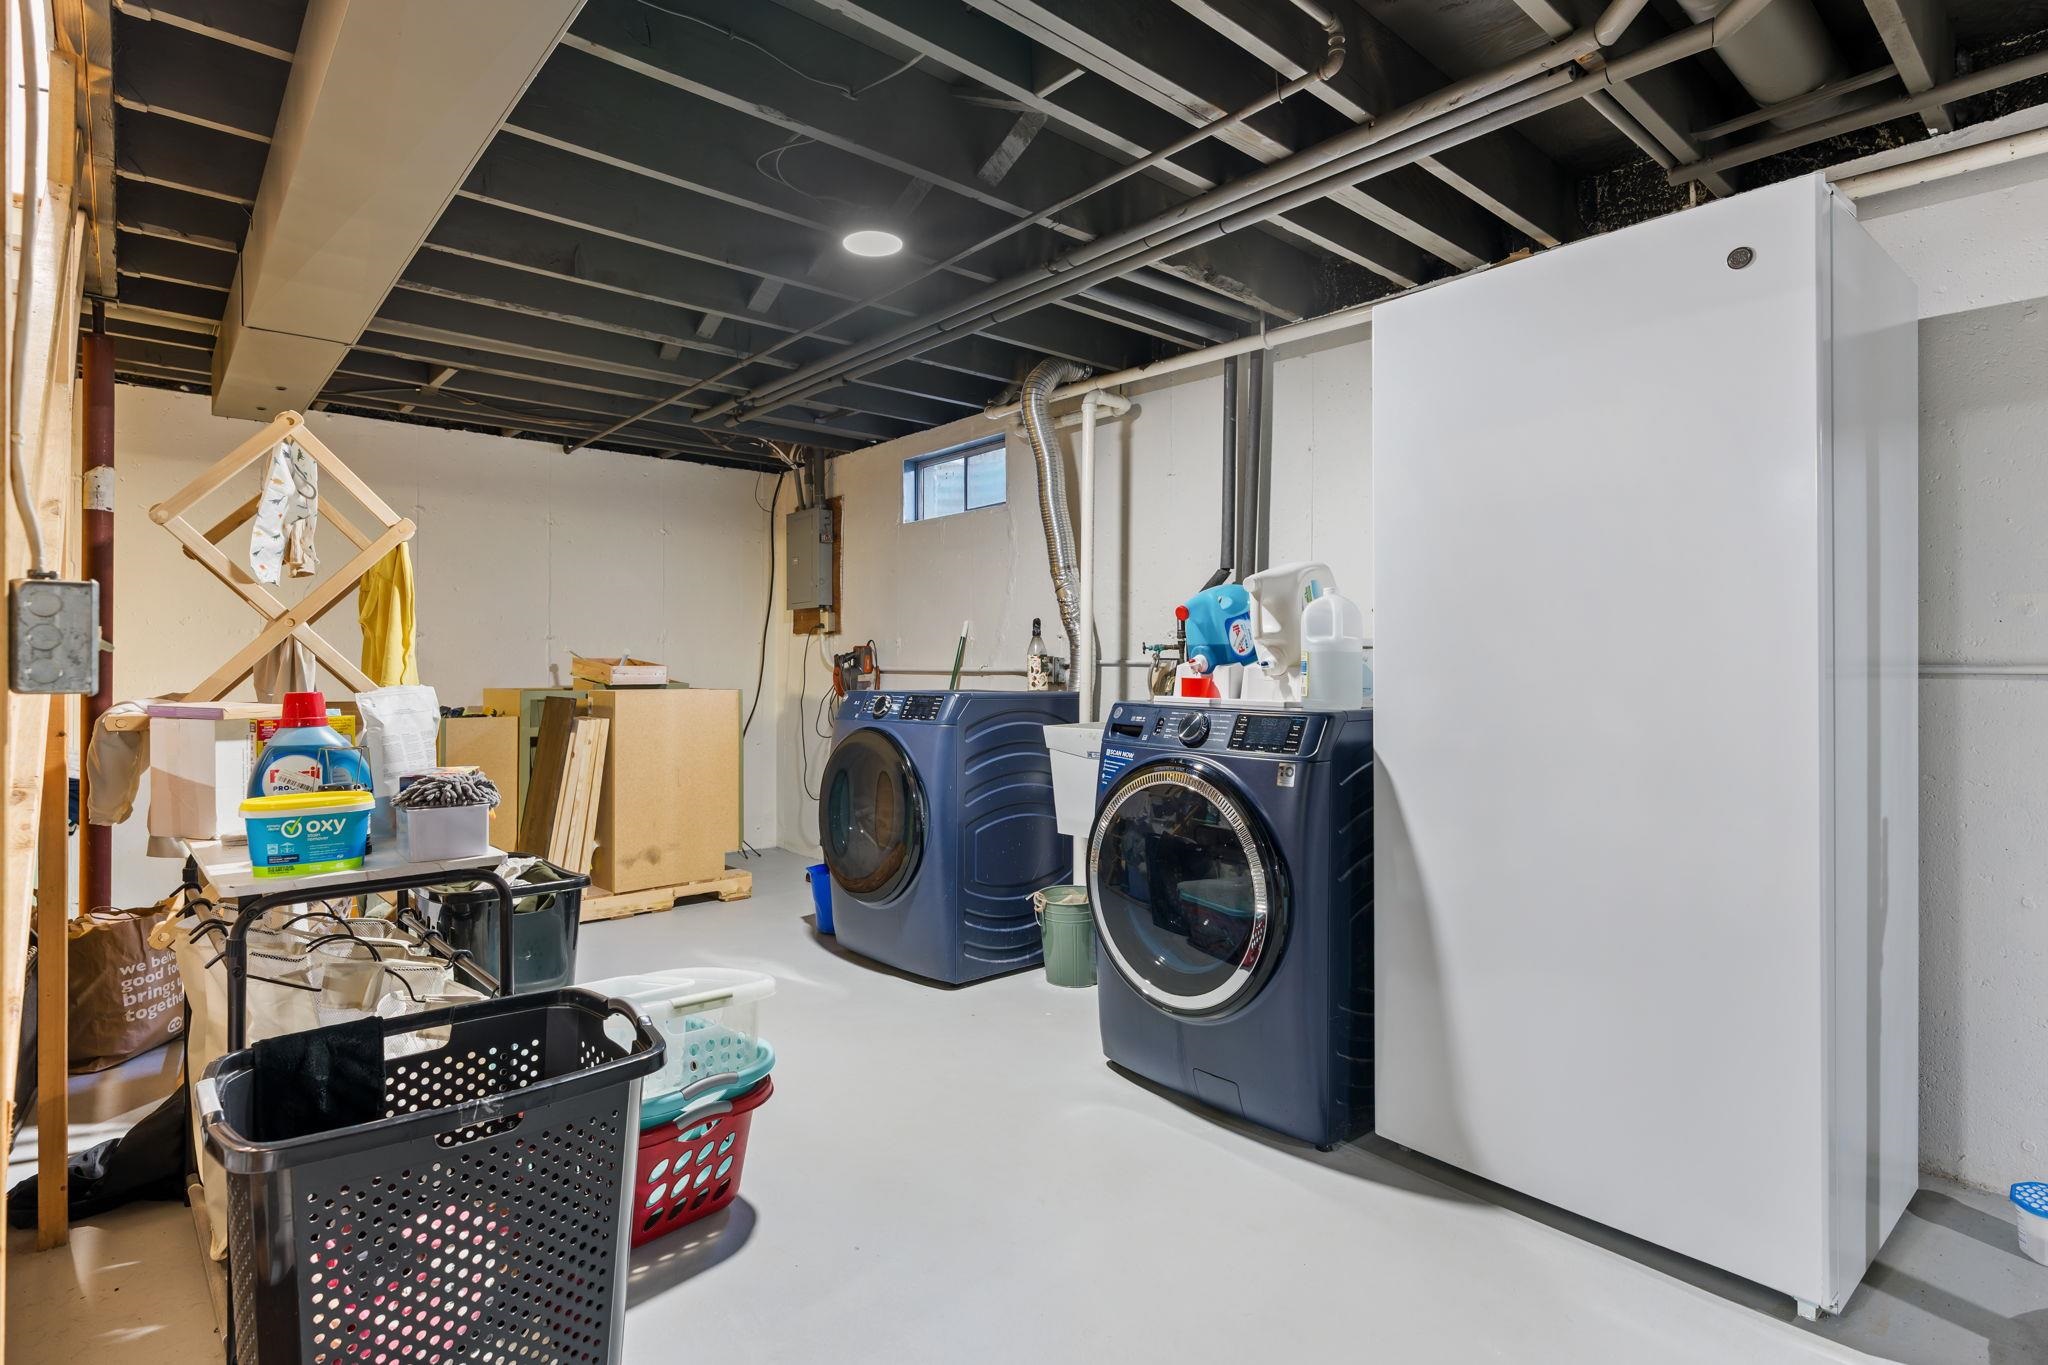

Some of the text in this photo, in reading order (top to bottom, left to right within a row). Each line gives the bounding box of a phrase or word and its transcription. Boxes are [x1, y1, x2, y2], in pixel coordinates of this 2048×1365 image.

[1110, 749, 1135, 759] SCAN NOW
[305, 818, 347, 835] oxy
[119, 951, 177, 976] we belie
[121, 967, 164, 993] good
[122, 980, 176, 1007] brings
[124, 992, 184, 1022] togethe
